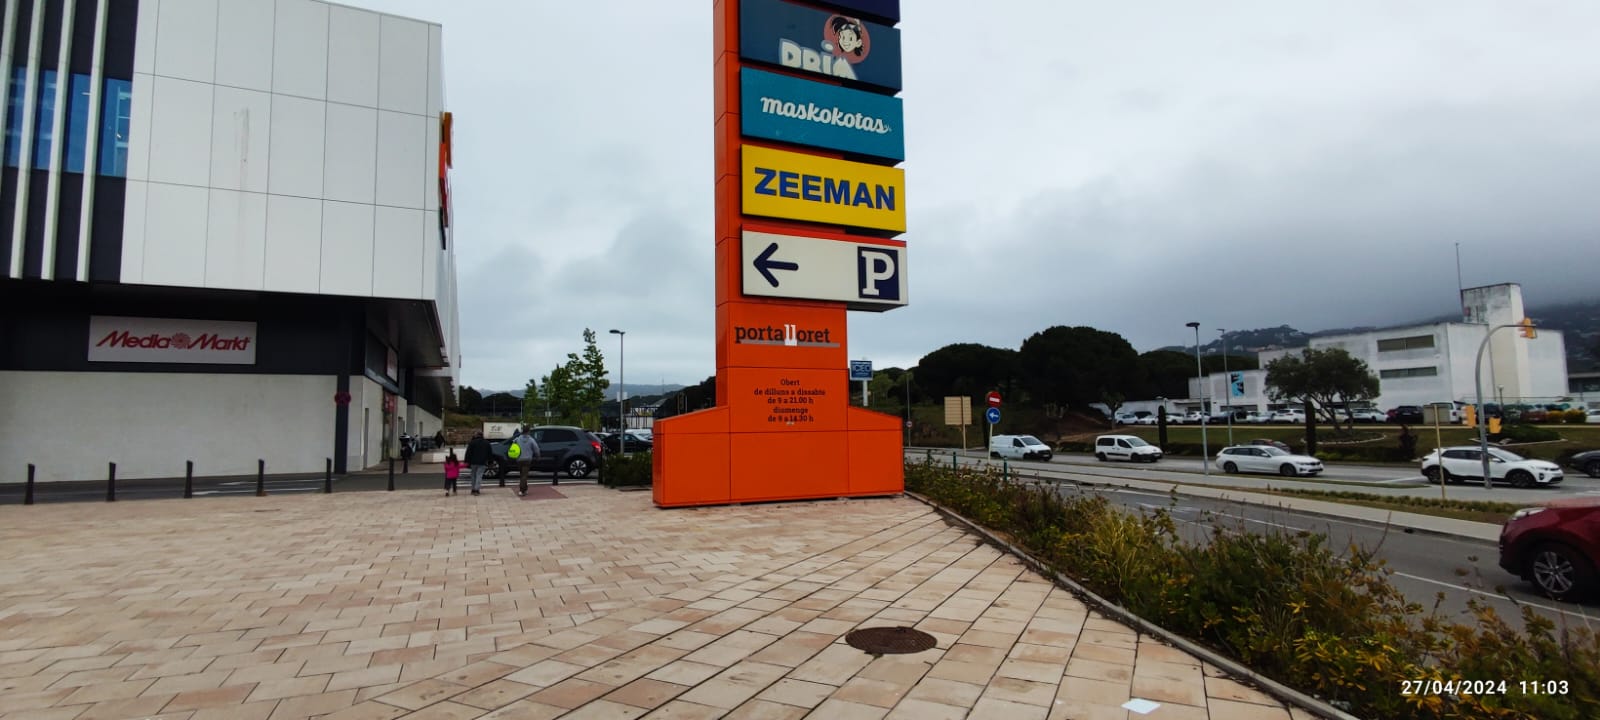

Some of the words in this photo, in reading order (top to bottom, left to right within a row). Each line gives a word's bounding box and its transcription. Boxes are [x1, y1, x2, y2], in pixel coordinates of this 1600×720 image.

[760, 97, 890, 134] maskokotas
[754, 166, 896, 211] ZEEMAN
[861, 250, 895, 296] P
[96, 330, 172, 349] Media
[187, 333, 250, 351] Markt
[735, 324, 831, 346] portalloret
[780, 377, 800, 386] Obert
